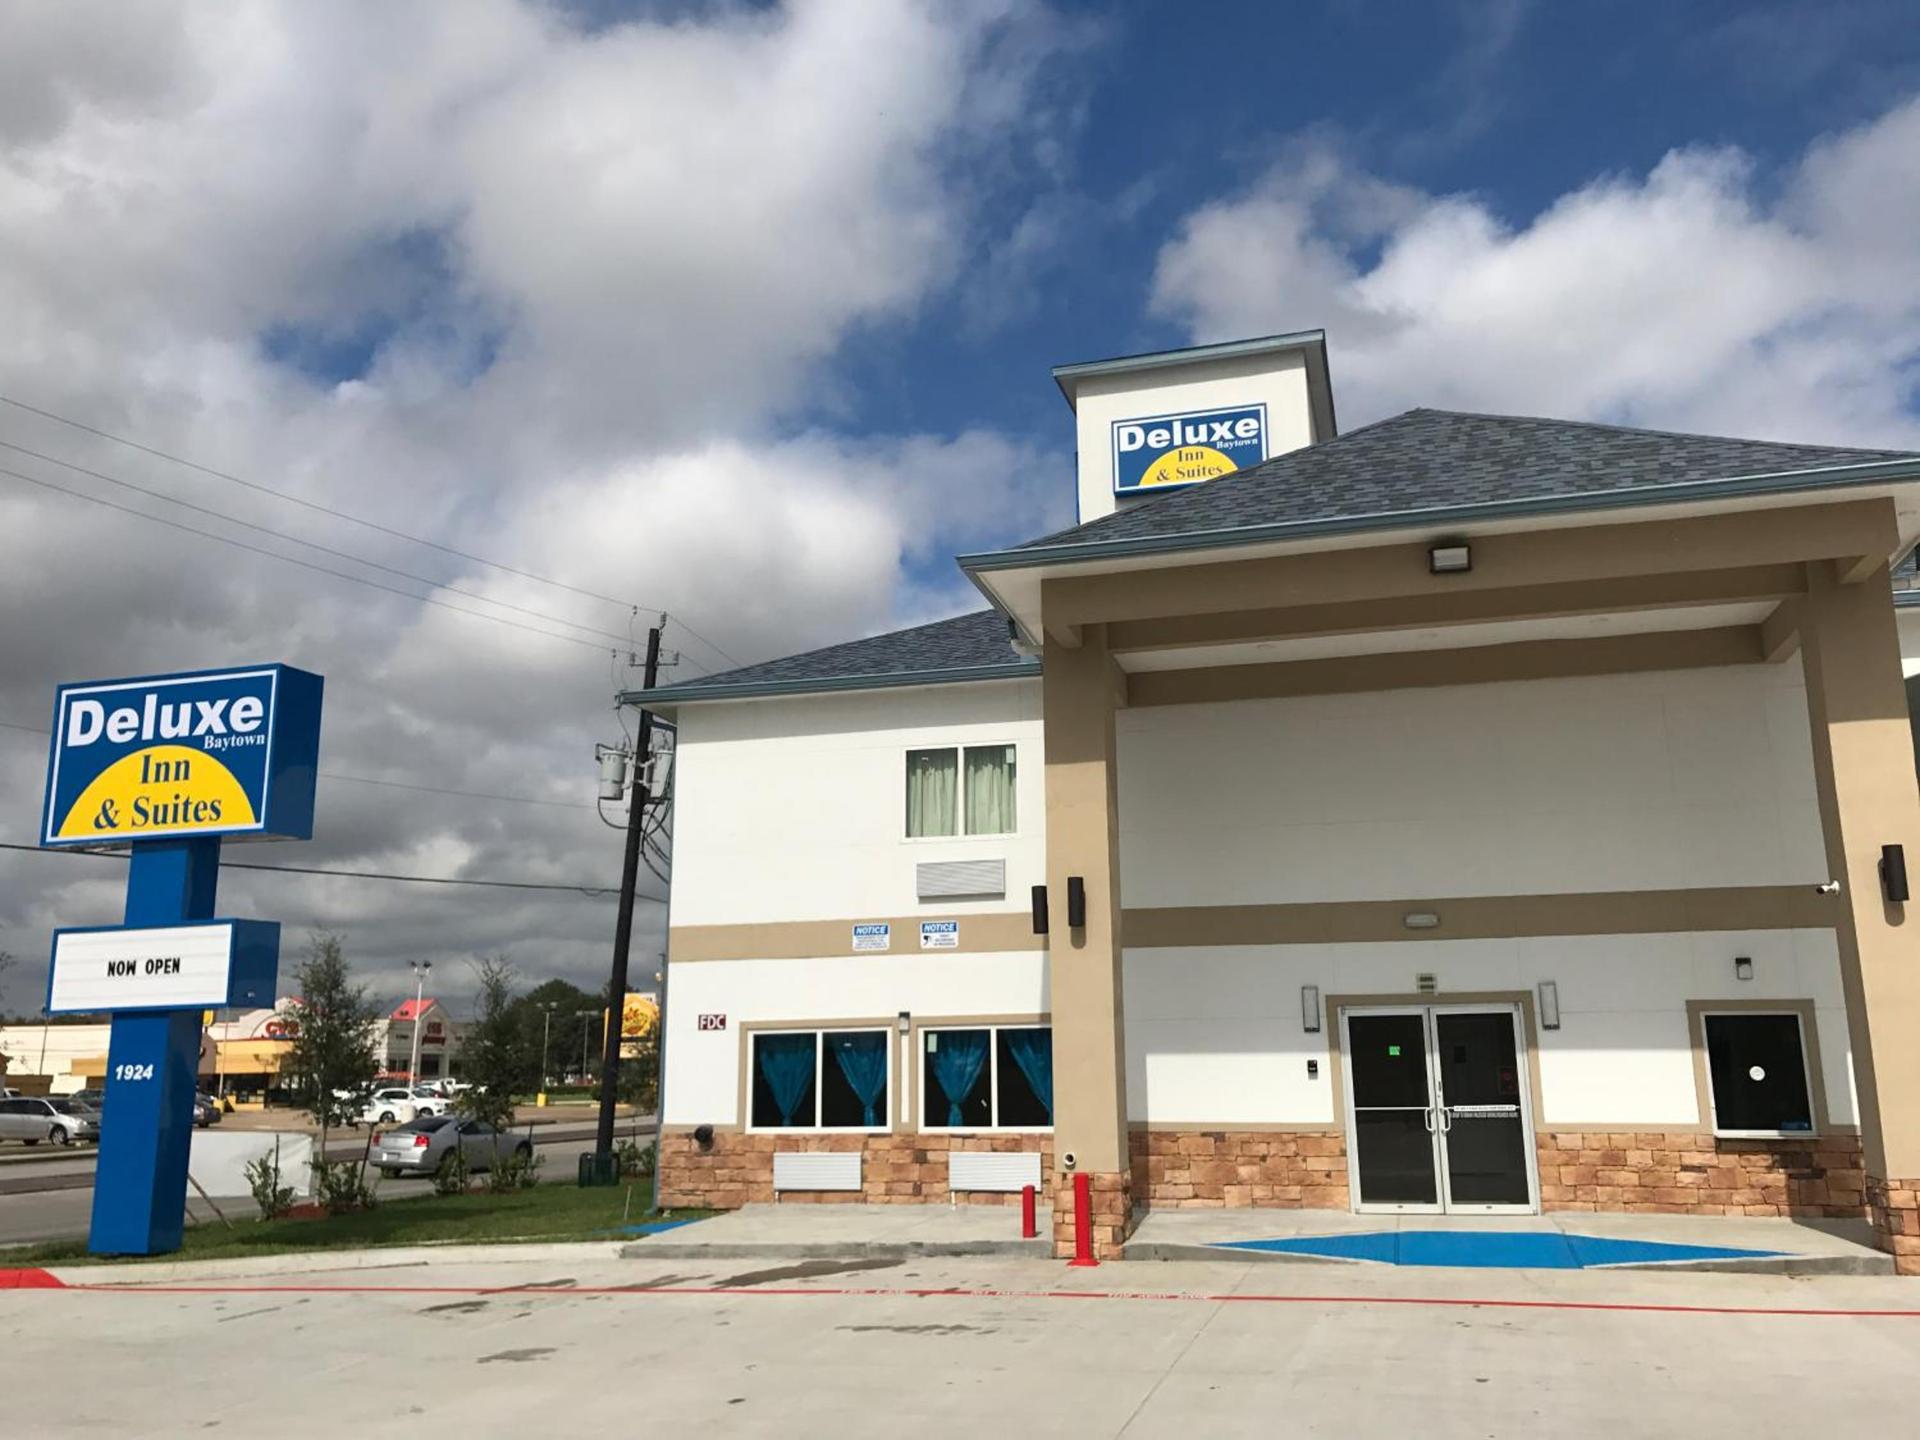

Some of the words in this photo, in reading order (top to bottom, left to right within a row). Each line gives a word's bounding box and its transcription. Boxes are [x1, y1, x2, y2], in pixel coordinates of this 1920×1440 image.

[1119, 417, 1260, 452] Deluxe
[1216, 438, 1258, 450] Baytown
[1178, 450, 1204, 463] Inn
[1156, 469, 1169, 482] &
[1176, 465, 1223, 480] Suites
[67, 693, 265, 748] Deluxe
[203, 733, 265, 752] Baytown
[141, 754, 190, 785] Inn
[94, 798, 120, 830] &
[131, 793, 222, 828] Suites
[855, 926, 887, 936] NOTICE
[923, 923, 955, 932] NOTICE
[107, 960, 137, 977] NOW
[145, 957, 181, 975] OPEN
[700, 1015, 725, 1029] FDC
[115, 1063, 155, 1082] 1924
